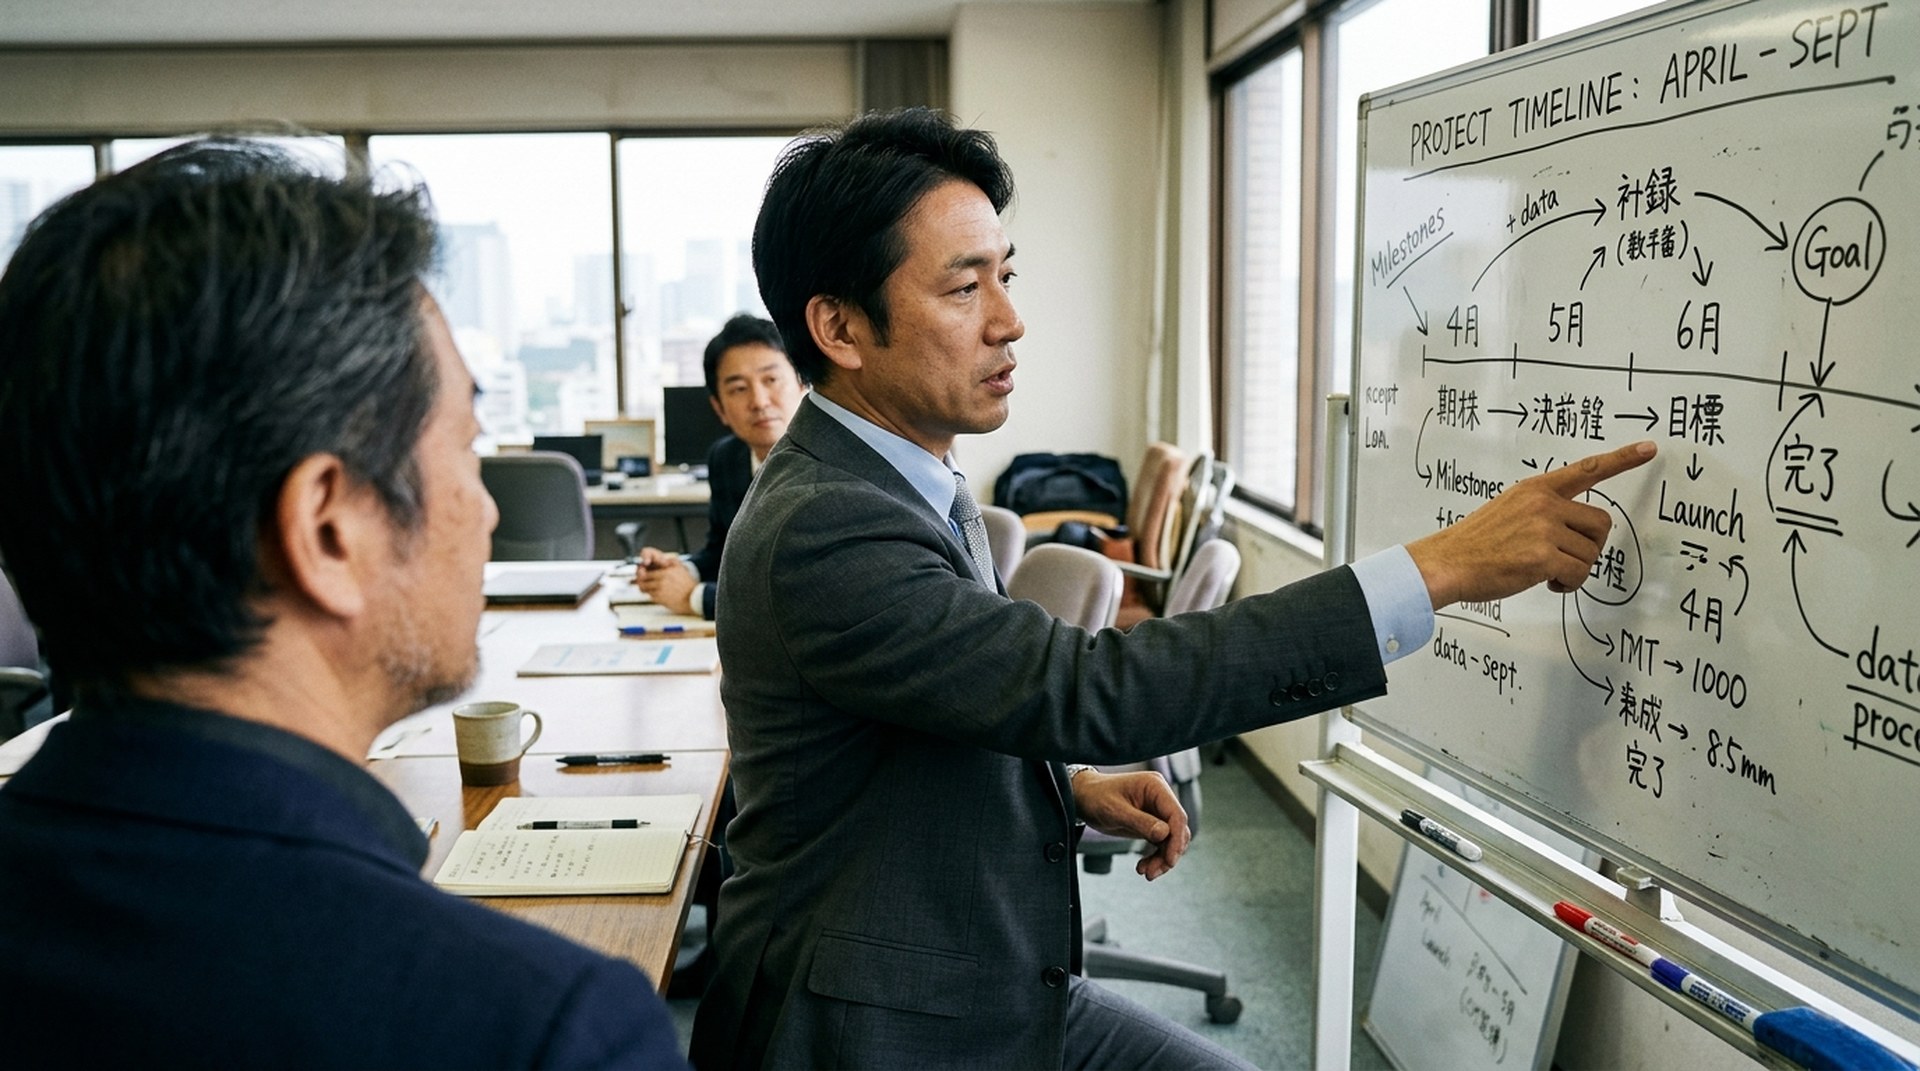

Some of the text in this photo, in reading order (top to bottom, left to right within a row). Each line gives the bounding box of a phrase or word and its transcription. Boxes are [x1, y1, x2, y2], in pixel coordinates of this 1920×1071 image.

[1410, 107, 1493, 166] PROJECT
[1508, 71, 1641, 138] TIMELINE:
[1660, 42, 1749, 104] APRIL
[1789, 2, 1889, 70] SEPT
[1520, 187, 1560, 228] data
[1371, 206, 1446, 288] Milestones
[1804, 220, 1874, 279] Goal
[1445, 303, 1480, 349] 4月
[1548, 300, 1585, 347] 5月
[1676, 300, 1721, 355] 6月
[1668, 393, 1726, 447] 目標
[1783, 433, 1839, 502] 完了
[1658, 479, 1746, 544] Launch
[1679, 587, 1723, 645] 4月
[1692, 656, 1748, 710] 1000
[1856, 624, 1920, 694] dat
[1626, 739, 1665, 799] 完了
